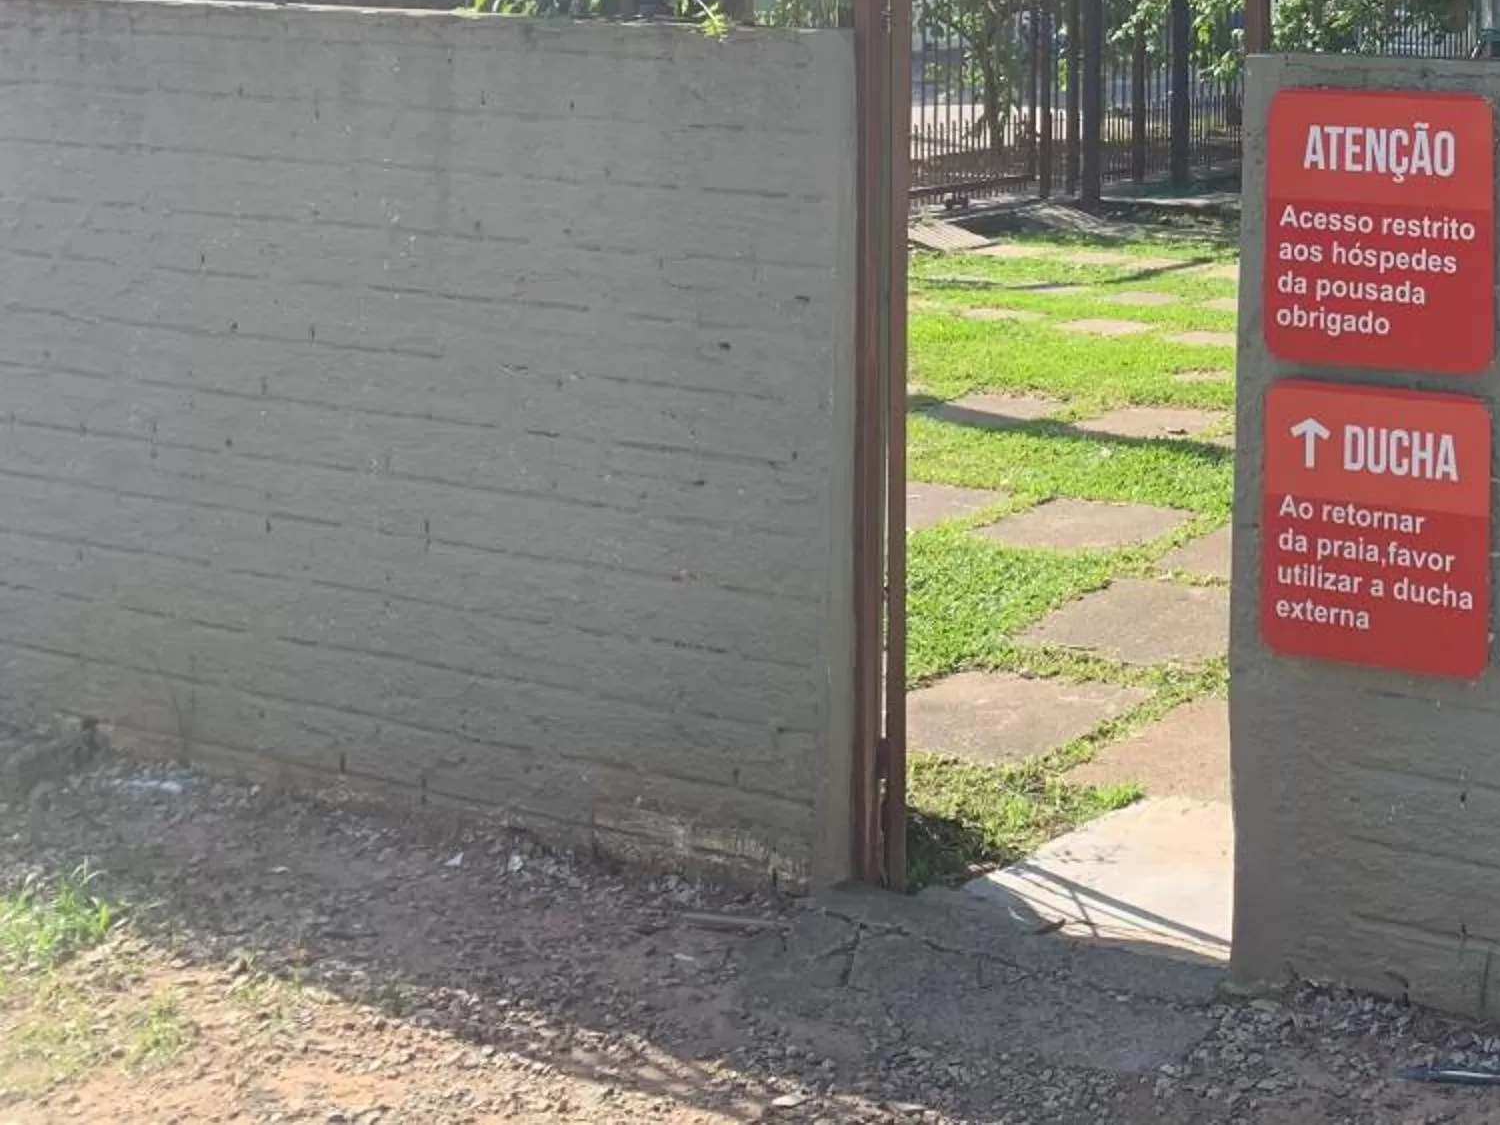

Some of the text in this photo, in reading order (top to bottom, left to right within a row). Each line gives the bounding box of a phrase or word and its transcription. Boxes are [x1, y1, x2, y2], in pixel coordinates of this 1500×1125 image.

[1303, 121, 1455, 183] ATENÇÃO
[1279, 204, 1475, 241] Acesso restrito
[1279, 241, 1457, 274] aos hóspedes
[1277, 271, 1426, 305] da pousada
[1276, 304, 1390, 336] obrigado
[1343, 424, 1459, 482] DUCHA
[1279, 494, 1425, 534] Ao retornar
[1278, 527, 1308, 553] da
[1277, 563, 1473, 610] utilizar a ducha
[1275, 598, 1370, 629] externa
